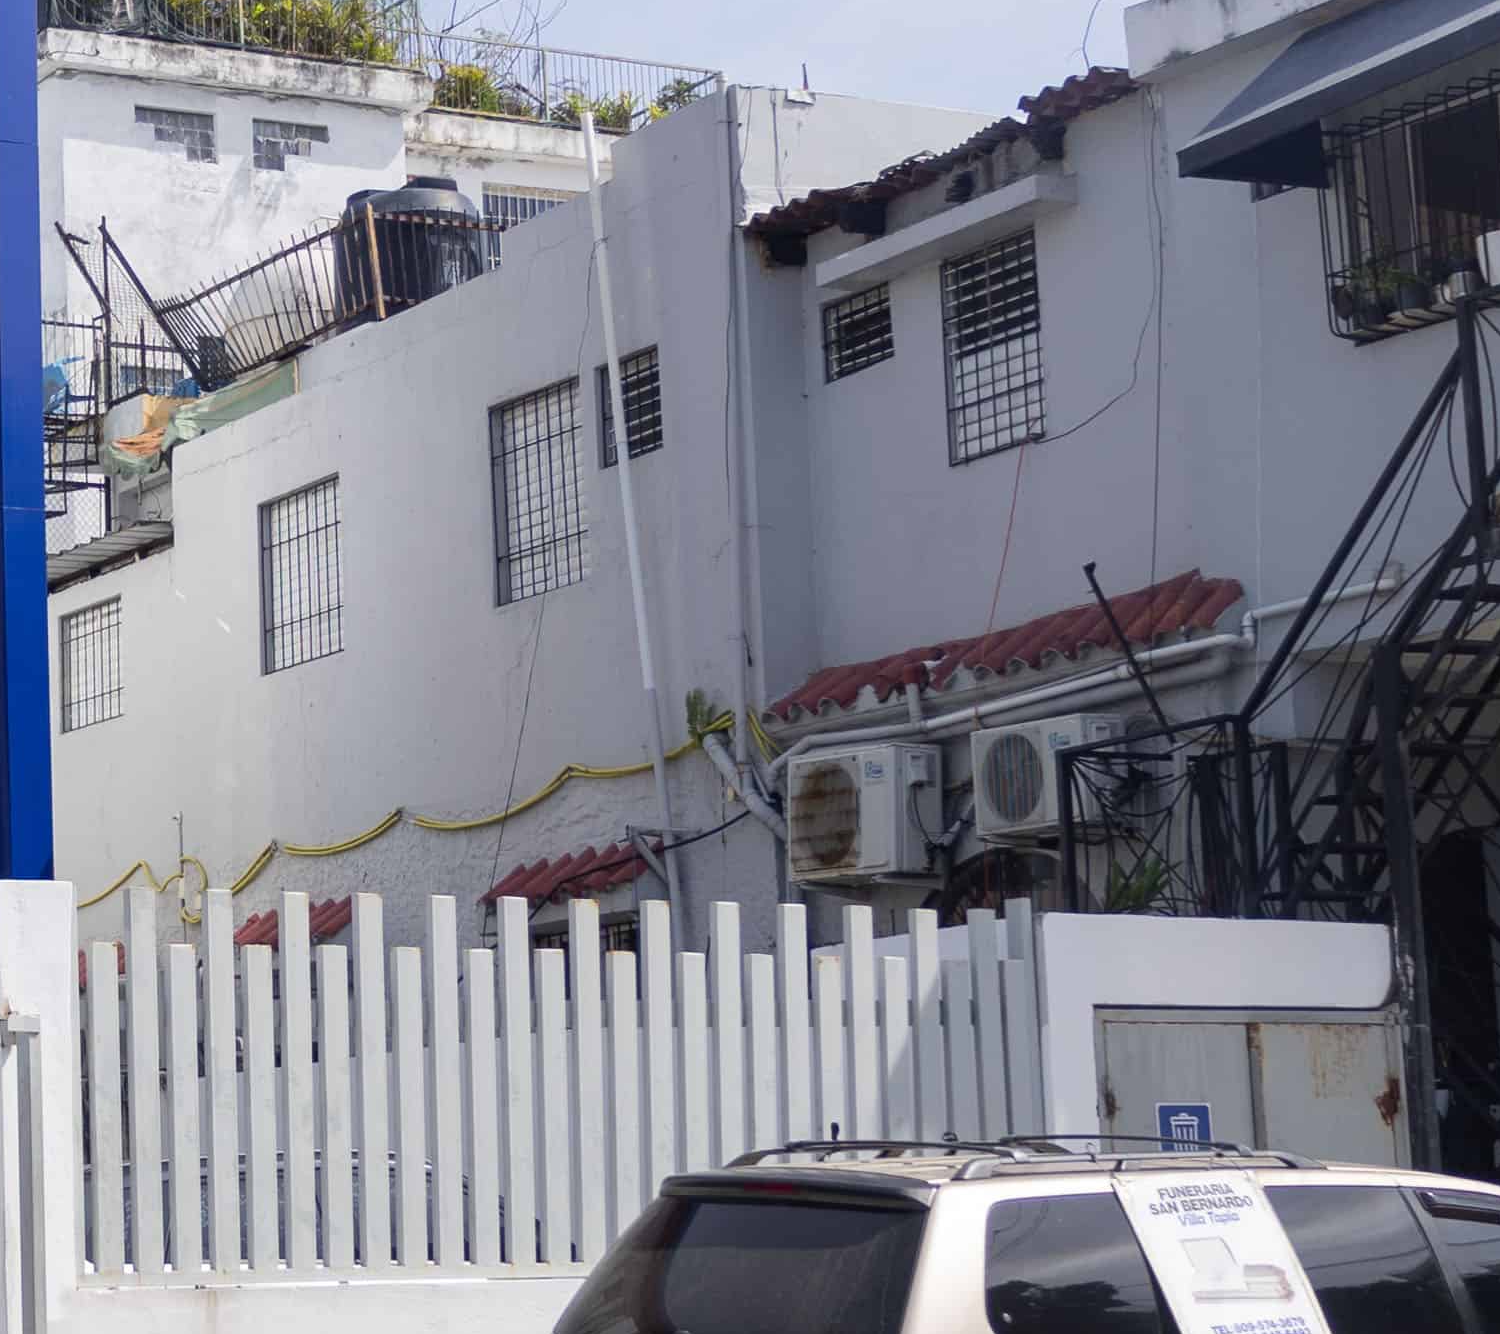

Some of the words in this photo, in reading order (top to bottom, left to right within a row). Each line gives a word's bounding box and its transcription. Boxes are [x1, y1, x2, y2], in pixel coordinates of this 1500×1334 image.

[1157, 1183, 1234, 1200] FUNERARIA
[1149, 1202, 1179, 1216] SAN
[1180, 1195, 1253, 1212] BERNARDO
